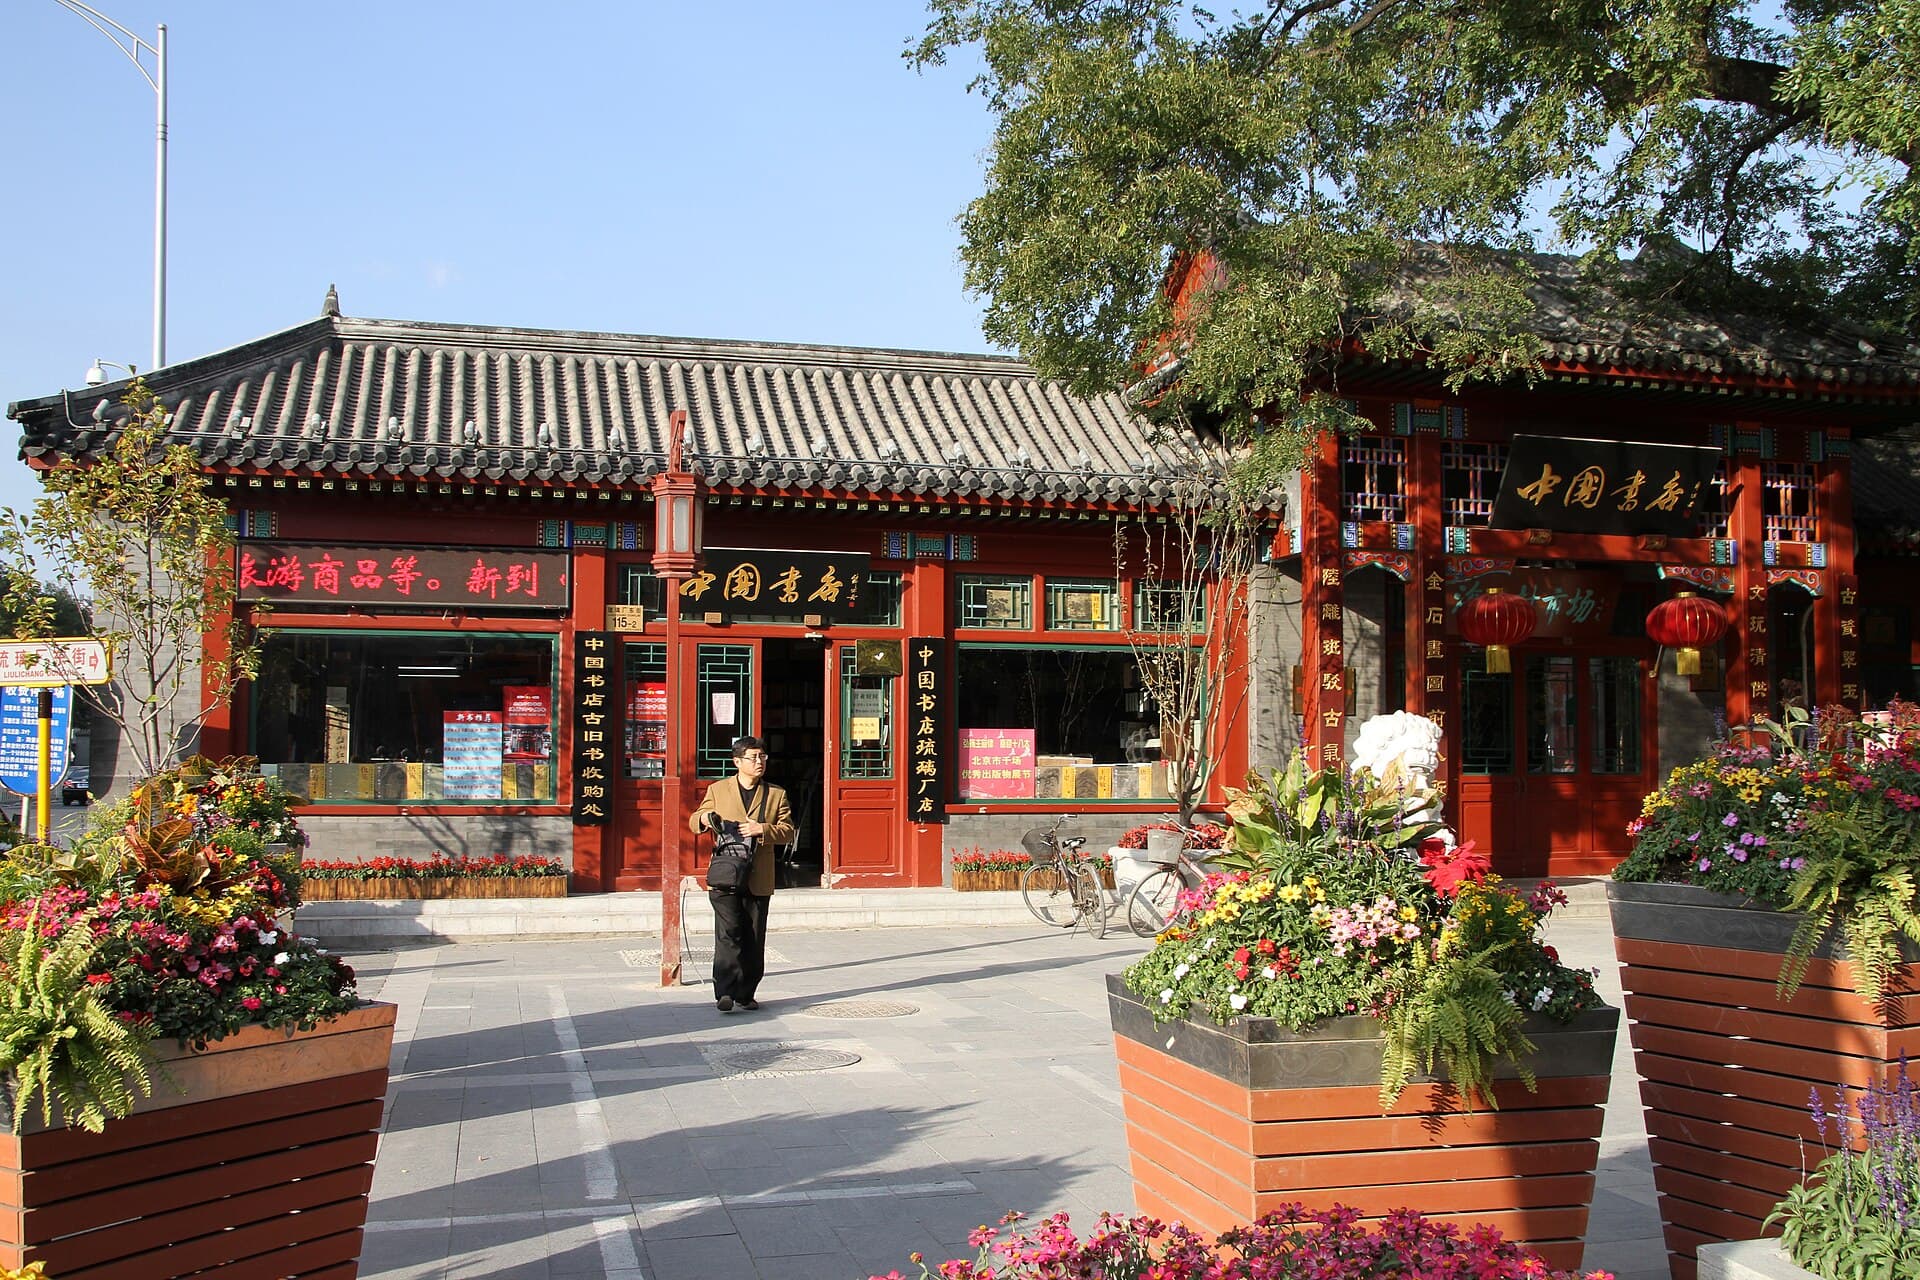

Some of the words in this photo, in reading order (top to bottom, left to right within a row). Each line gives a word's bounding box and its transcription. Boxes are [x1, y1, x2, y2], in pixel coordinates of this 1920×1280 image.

[466, 558, 539, 599] 新到
[613, 617, 637, 628] 115-2
[582, 637, 605, 817] 中国书店古旧书收购处
[915, 645, 938, 813] 中国书店琉璃厂店
